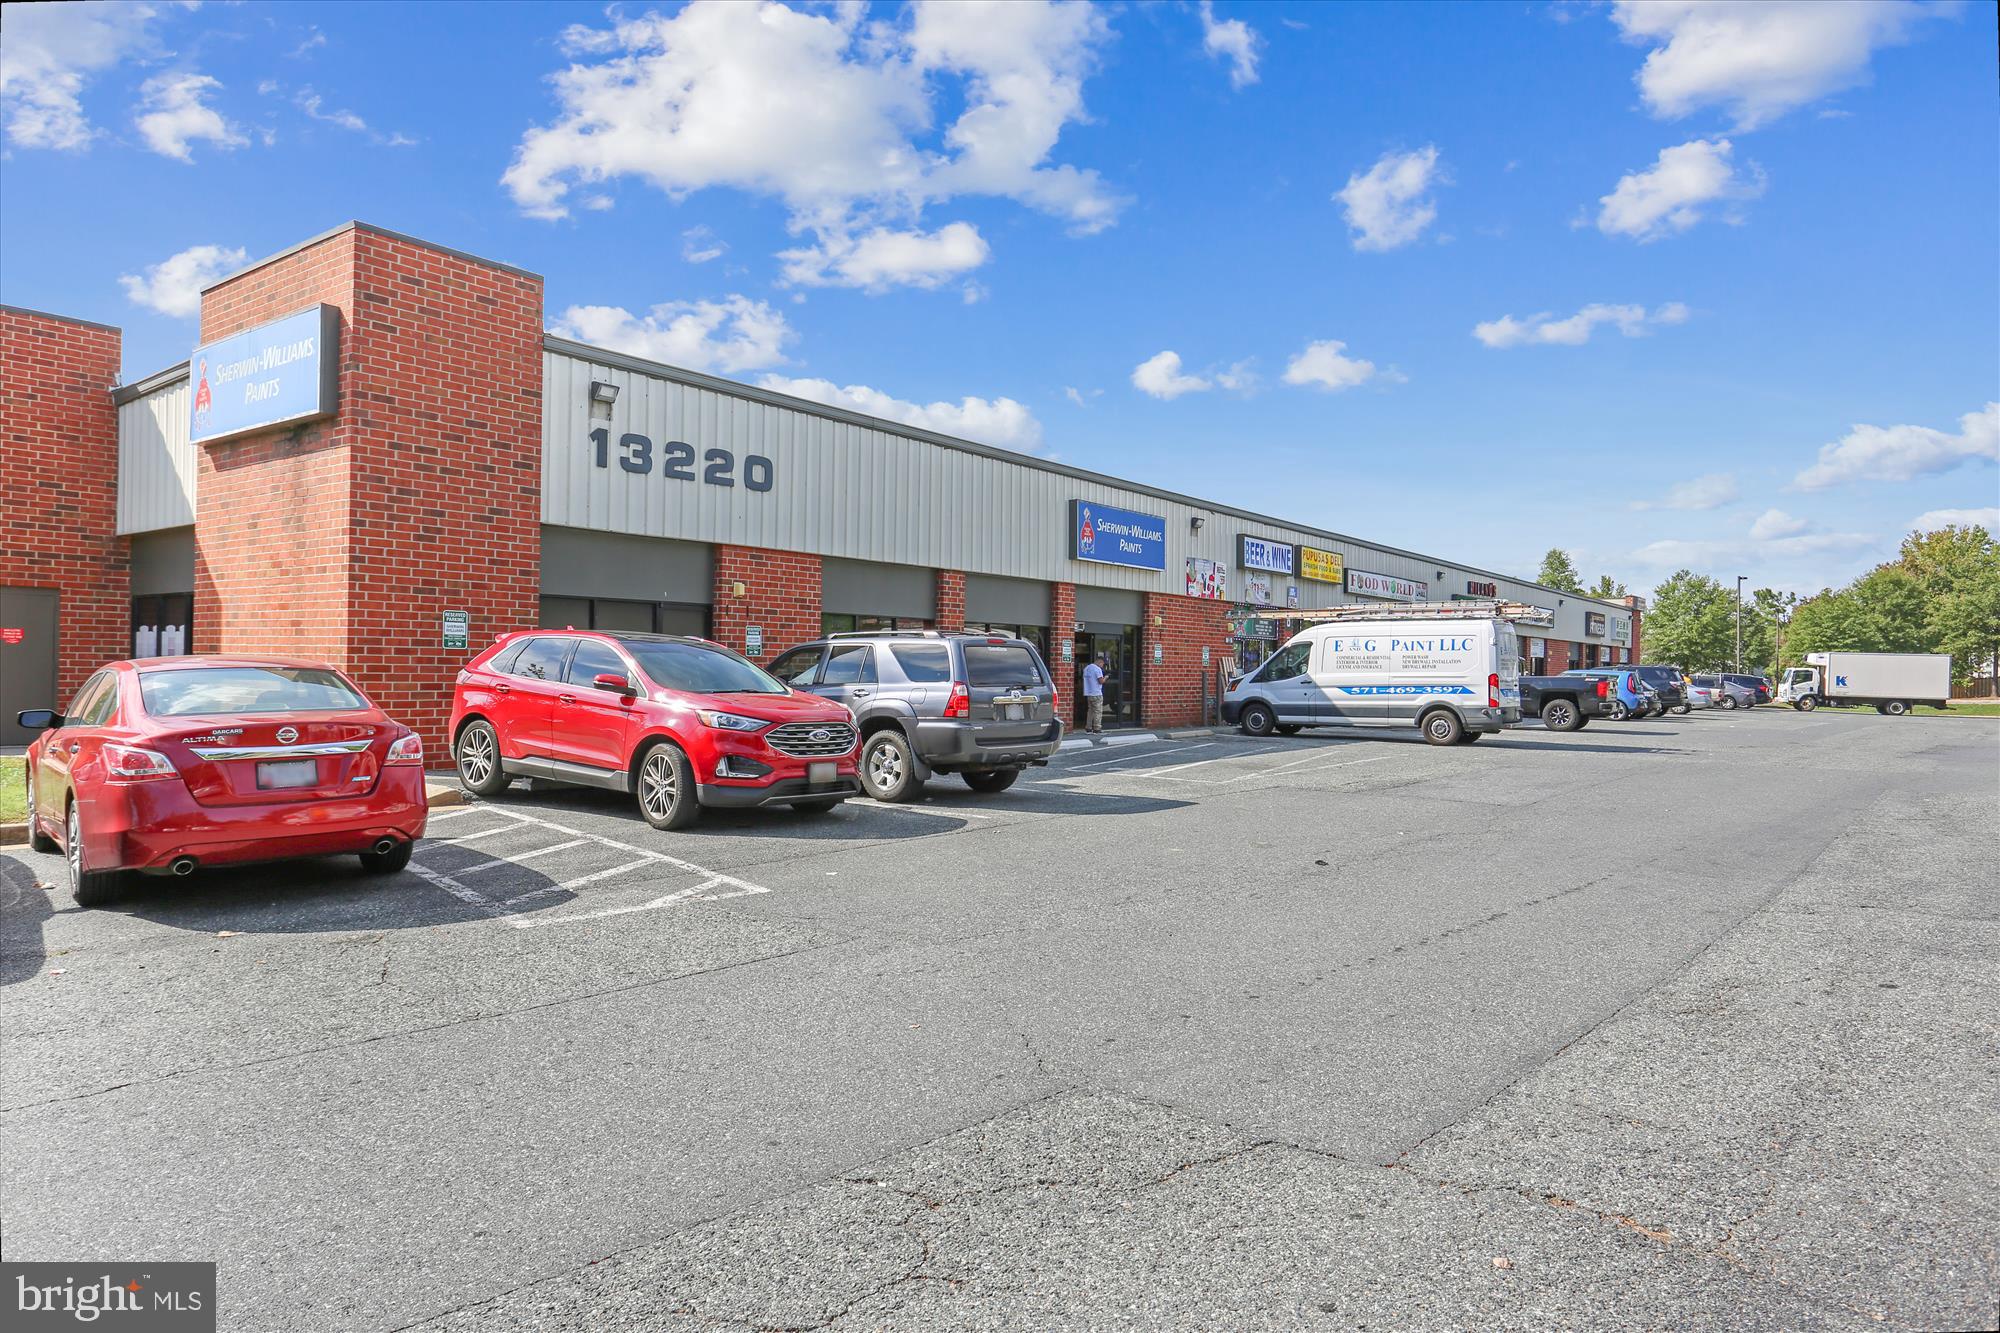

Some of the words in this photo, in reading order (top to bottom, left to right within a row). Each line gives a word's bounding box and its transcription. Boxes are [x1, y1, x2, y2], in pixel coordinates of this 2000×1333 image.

[215, 337, 314, 386] SHERWIN-WILLIAMS
[245, 378, 280, 405] PAINTS
[589, 427, 774, 493] 13220
[1097, 518, 1163, 542] SHERWIN-WILLIAMS
[1119, 538, 1142, 554] PAINTS
[1246, 541, 1265, 566] BEER
[1266, 550, 1271, 567] &
[1272, 546, 1291, 570] WINE
[1303, 549, 1329, 564] PUPUSAS
[1330, 555, 1342, 567] DELI
[1350, 573, 1379, 591] FOOD
[1381, 580, 1414, 596] WORLD
[1335, 639, 1344, 652] E
[1364, 639, 1377, 652] G
[1391, 639, 1435, 652] PAINT
[1440, 638, 1474, 651] LLC
[1350, 686, 1464, 694] 571-469-3597
[181, 736, 225, 744] ALTIMA
